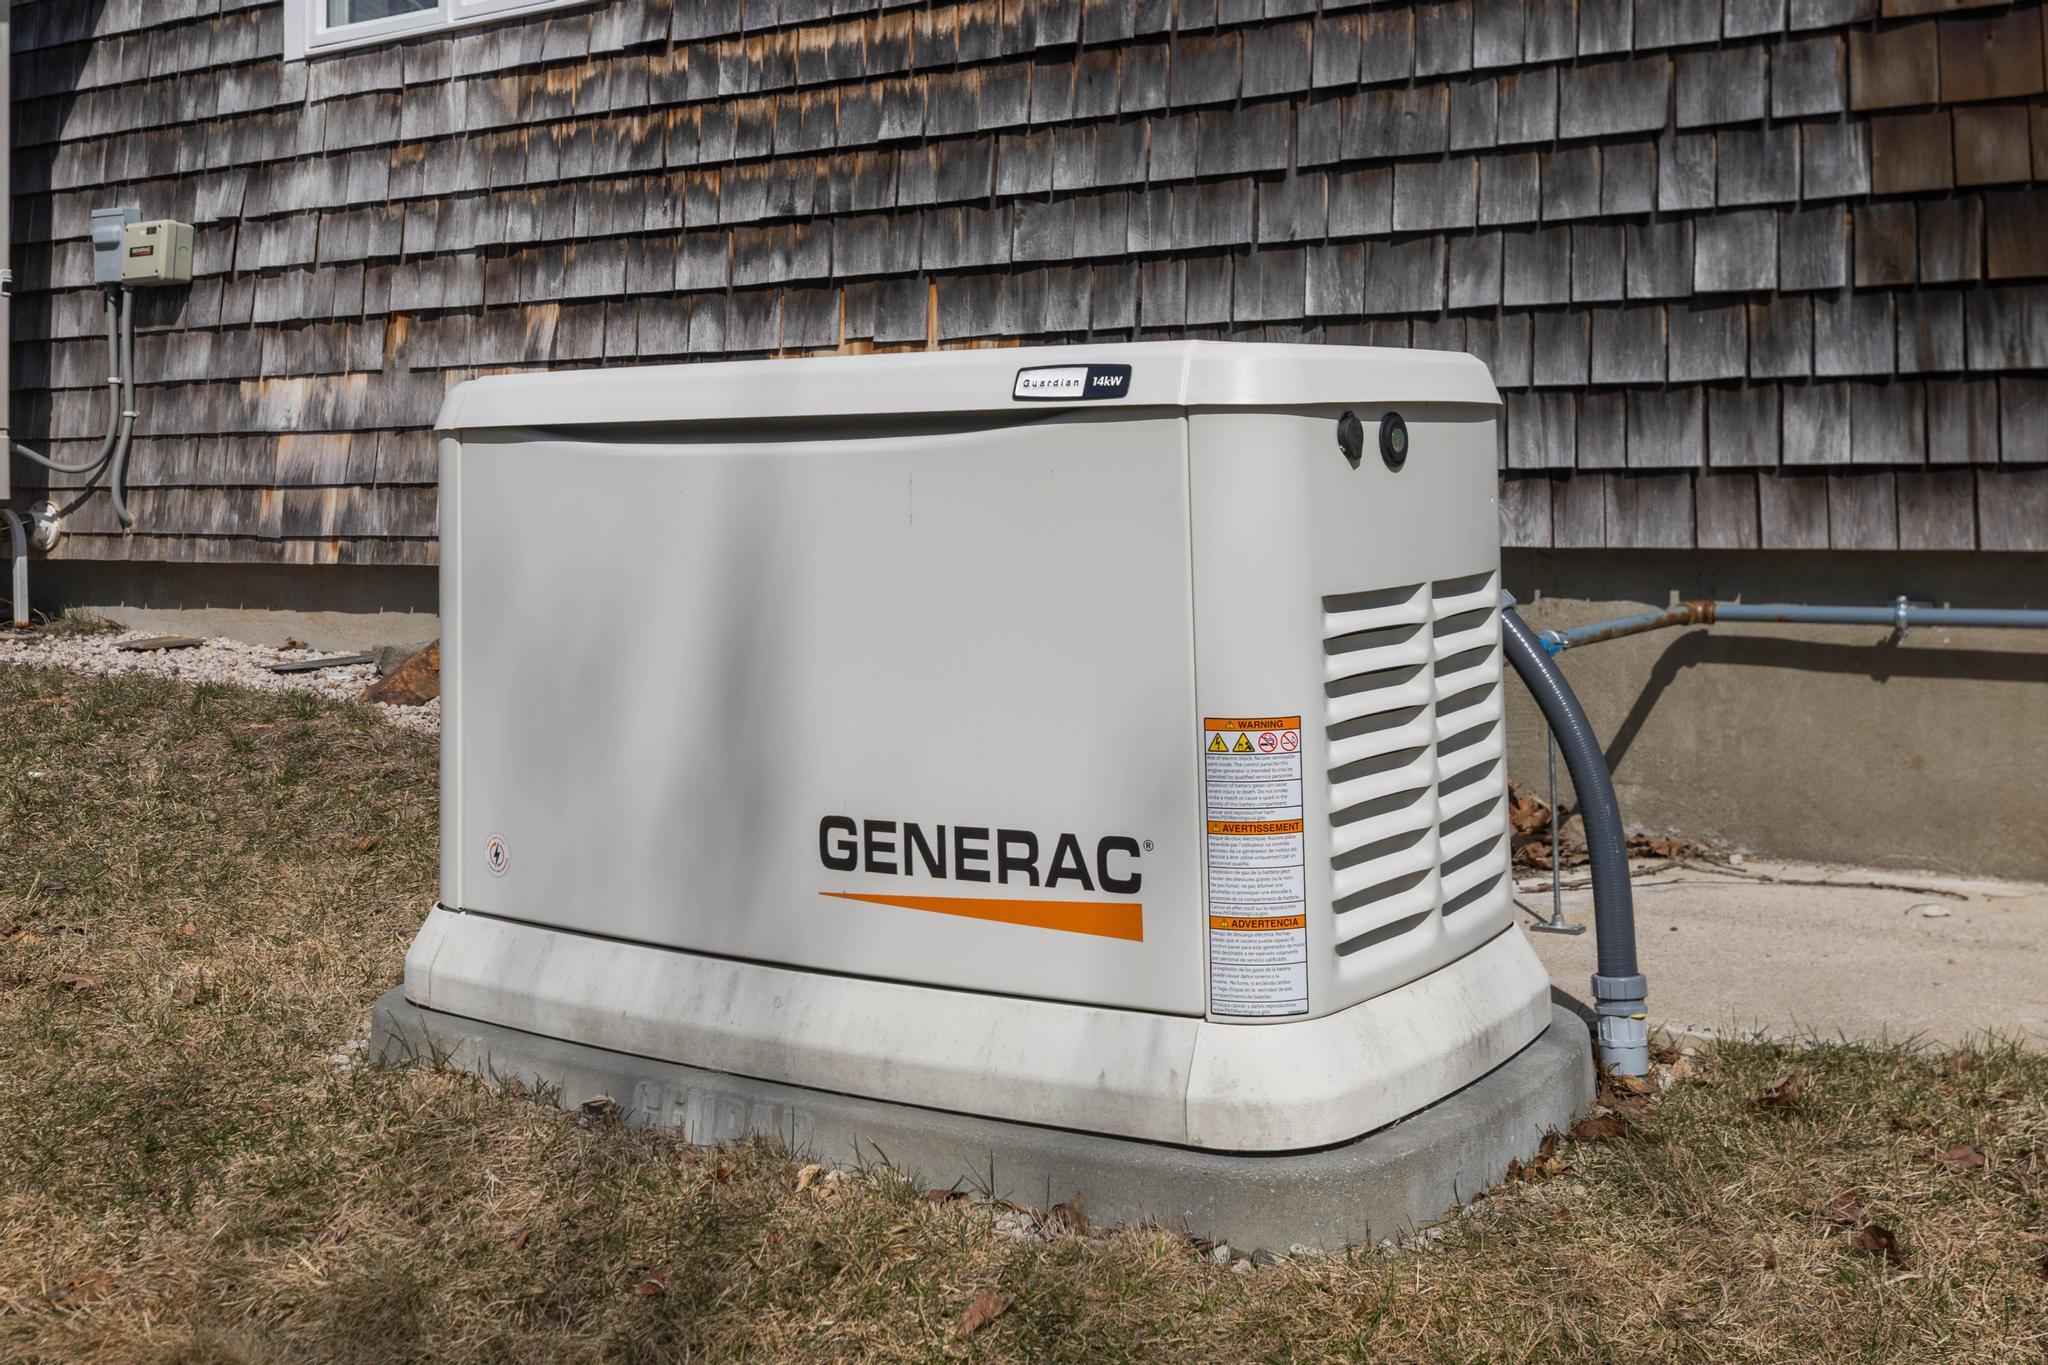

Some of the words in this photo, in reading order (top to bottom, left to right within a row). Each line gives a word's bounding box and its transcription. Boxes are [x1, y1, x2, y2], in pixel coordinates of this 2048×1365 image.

[1023, 379, 1079, 387] Guardian
[1093, 376, 1123, 386] 14kW
[1238, 720, 1283, 728] WARNING
[1222, 822, 1300, 832] AVERTISSEMENT
[1231, 918, 1299, 928] ADVERTENCIA
